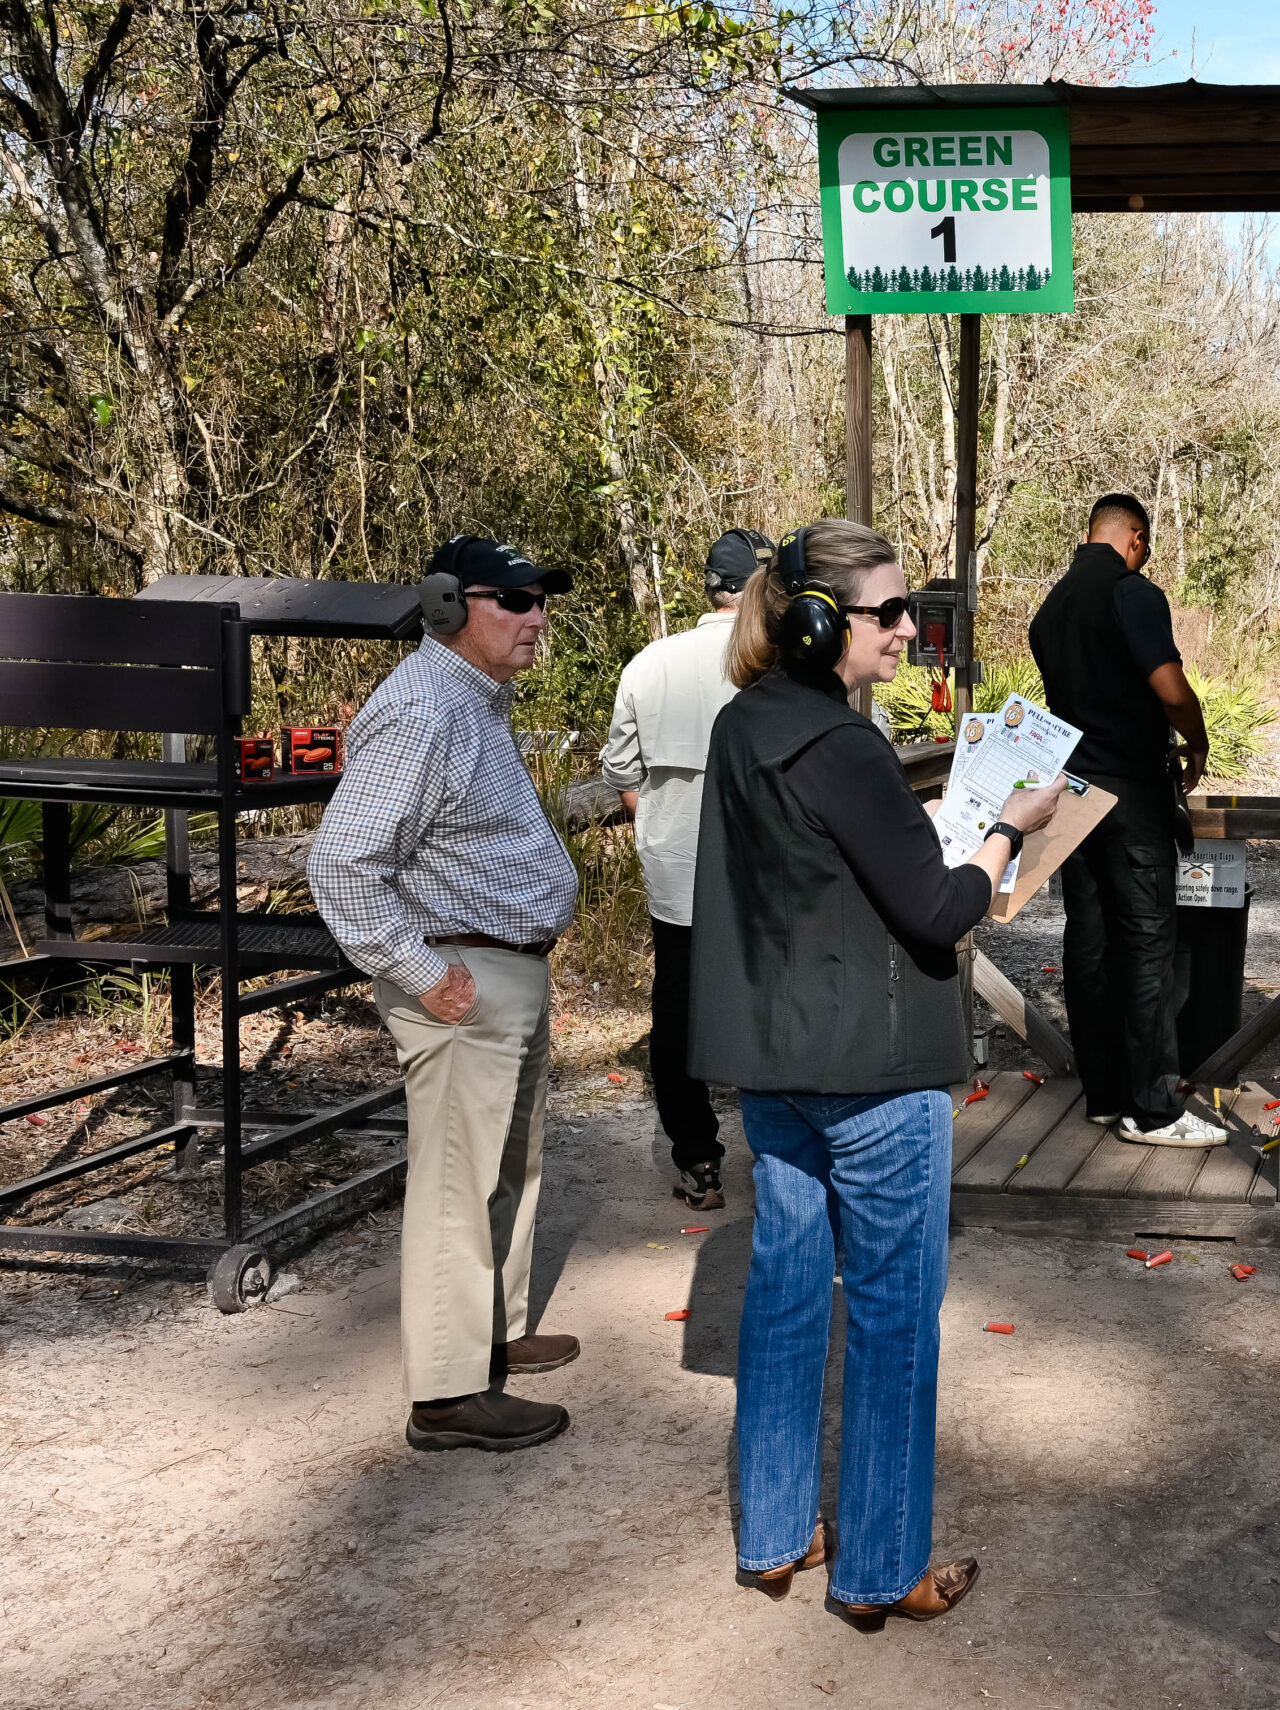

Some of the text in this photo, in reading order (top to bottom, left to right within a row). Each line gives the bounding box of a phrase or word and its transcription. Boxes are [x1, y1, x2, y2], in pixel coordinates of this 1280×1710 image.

[873, 136, 1013, 168] GREEN
[853, 178, 1038, 213] COURSE
[930, 216, 957, 263] 1
[1027, 709, 1044, 722] PULL
[1054, 724, 1072, 738] CURE
[262, 769, 271, 777] 25
[323, 762, 334, 770] 25
[1178, 893, 1193, 901] Action
